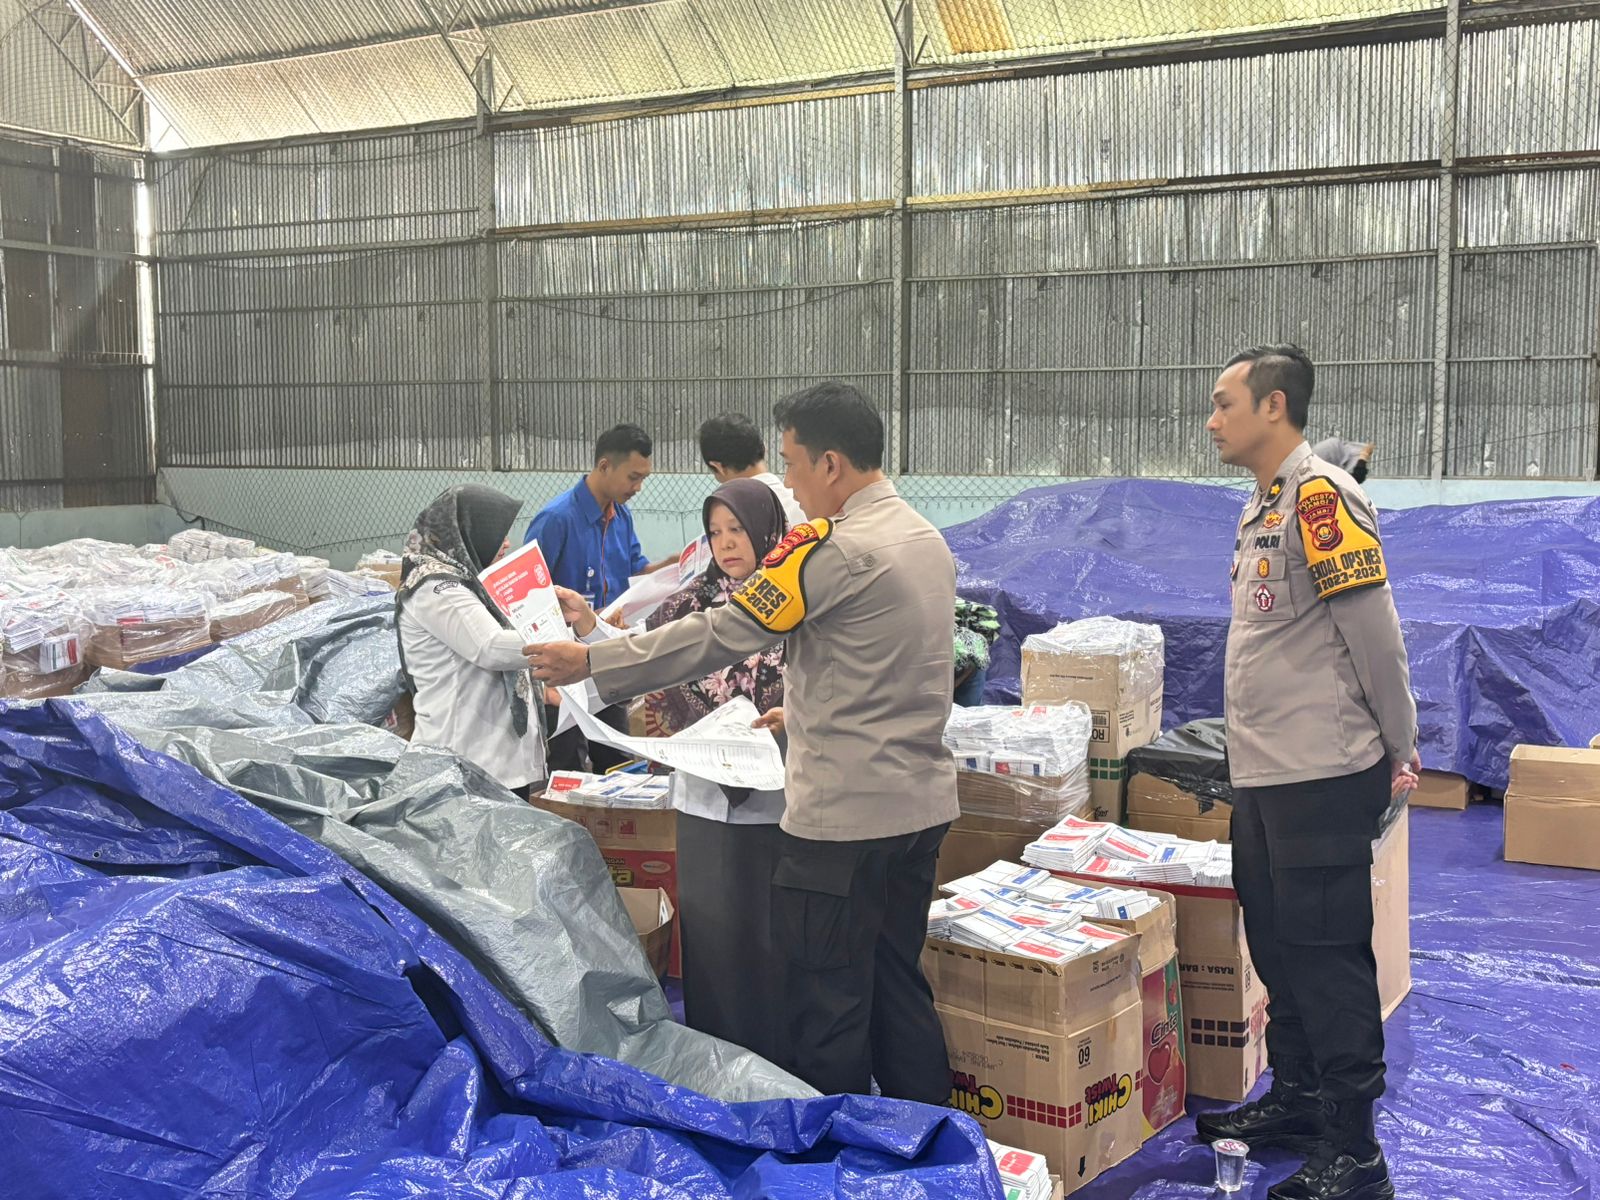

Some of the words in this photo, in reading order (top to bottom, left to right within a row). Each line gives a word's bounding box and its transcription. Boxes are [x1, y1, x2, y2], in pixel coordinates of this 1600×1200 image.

[1255, 535, 1280, 550] POLRI
[1309, 556, 1341, 582] ENDAL
[1340, 550, 1363, 570] OPS
[1362, 547, 1381, 566] RES
[1321, 564, 1382, 590] 2023-2024
[754, 578, 787, 610] RES
[1091, 728, 1105, 741] RO
[1179, 963, 1199, 973] BAR
[1207, 964, 1235, 975] RASA
[1078, 1045, 1091, 1065] 60
[1087, 1073, 1132, 1127] CHIKI
